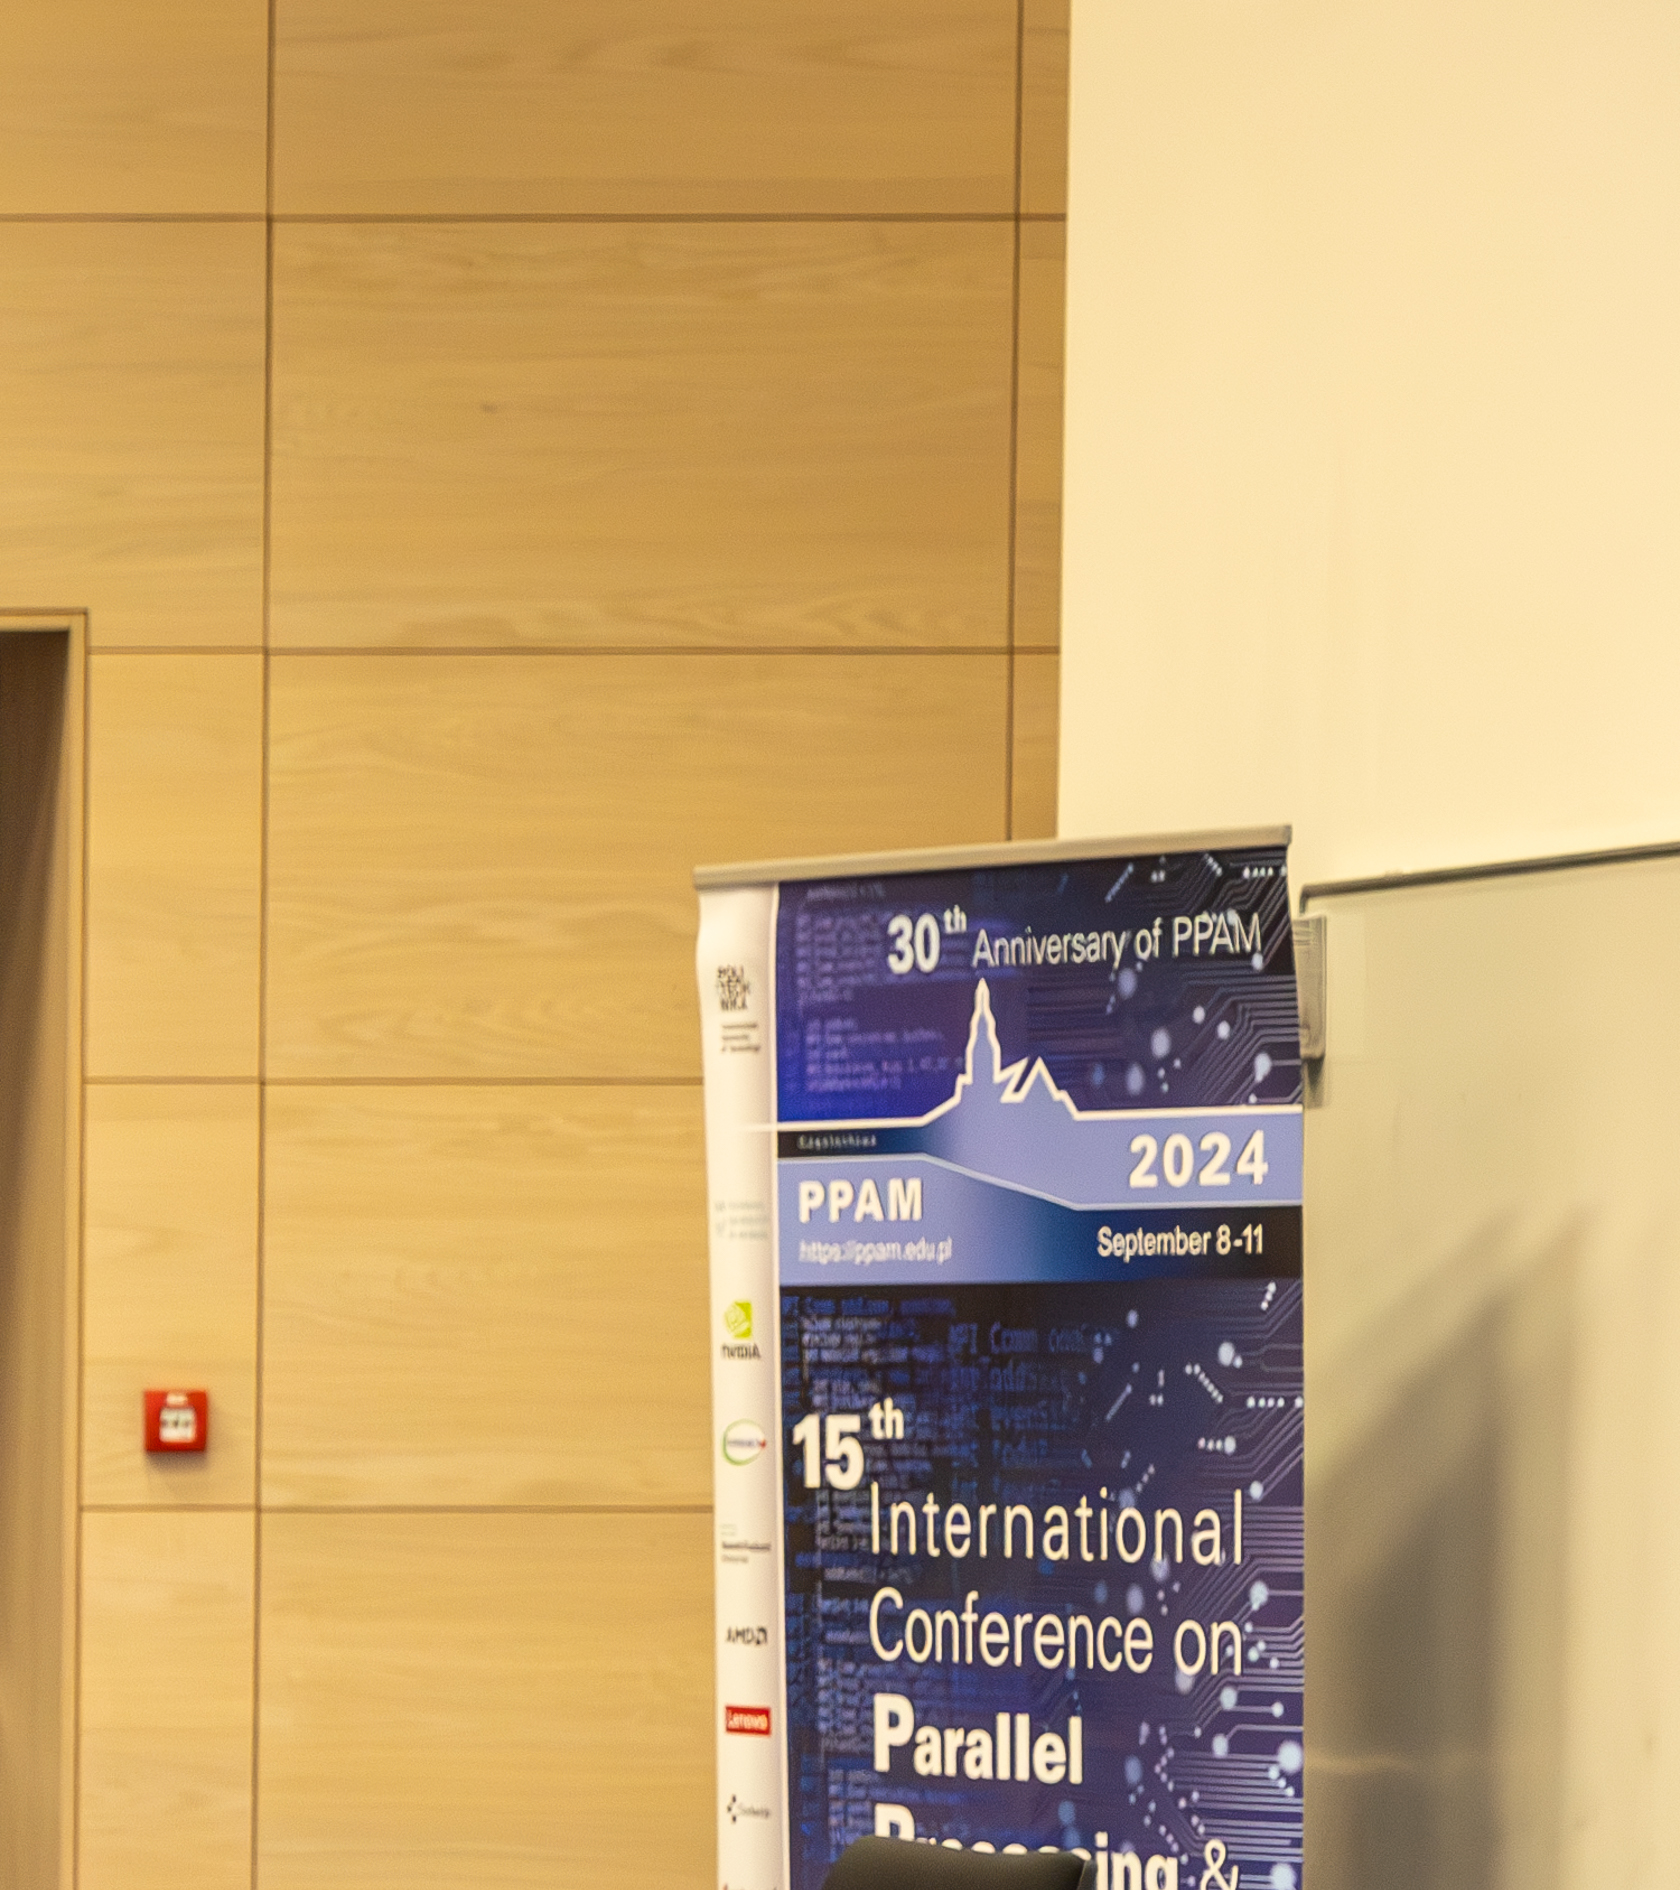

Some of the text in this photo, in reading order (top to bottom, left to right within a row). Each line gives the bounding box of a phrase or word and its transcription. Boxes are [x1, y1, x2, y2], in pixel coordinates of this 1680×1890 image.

[971, 924, 1131, 970] Anniversary
[1134, 917, 1163, 962] of
[1172, 911, 1262, 958] PPAM
[1129, 1129, 1269, 1189] 2024
[799, 1177, 923, 1224] PPAM
[1097, 1225, 1212, 1263] September
[792, 1397, 905, 1490] 15th
[870, 1481, 1244, 1565] International
[869, 1586, 1244, 1676] Conference on
[873, 1692, 1083, 1784] Parallel
